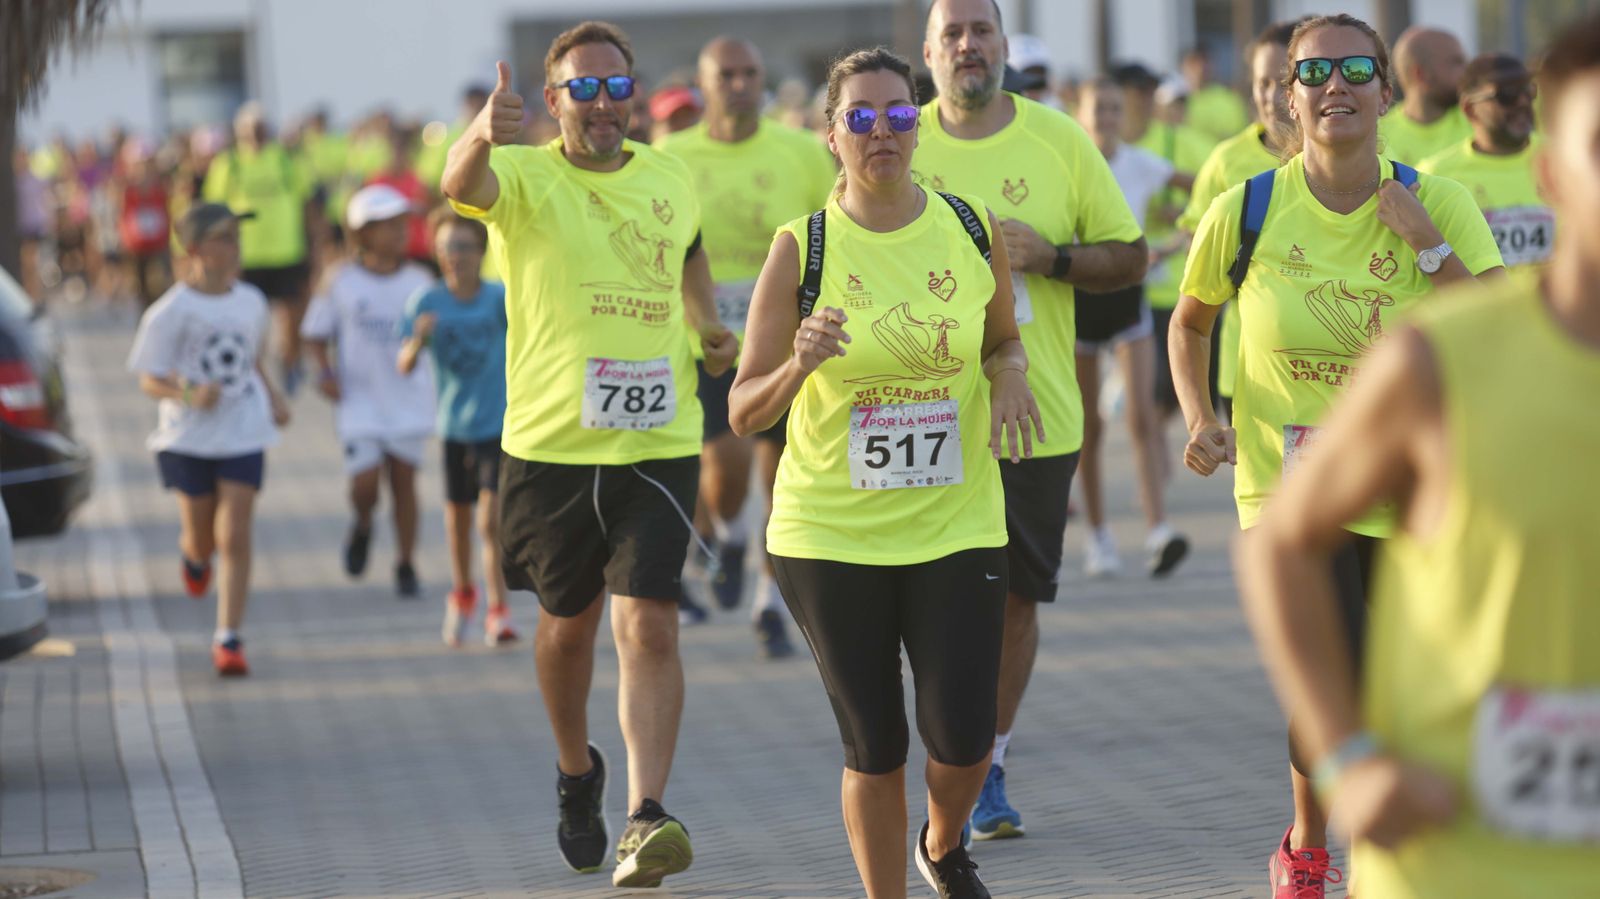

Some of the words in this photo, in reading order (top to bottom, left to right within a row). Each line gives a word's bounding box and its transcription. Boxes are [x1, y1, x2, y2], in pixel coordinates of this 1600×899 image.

[593, 294, 612, 304] VII
[591, 305, 617, 315] POR
[622, 307, 637, 318] LA
[1289, 360, 1312, 370] VII
[1291, 371, 1321, 381] POR
[1325, 375, 1343, 386] LA
[599, 384, 666, 414] 782
[855, 387, 878, 399] VII
[882, 386, 949, 401] CARRERA
[869, 417, 896, 427] POR
[900, 417, 915, 426] LA
[918, 413, 953, 425] MUJER
[864, 431, 948, 469] 517
